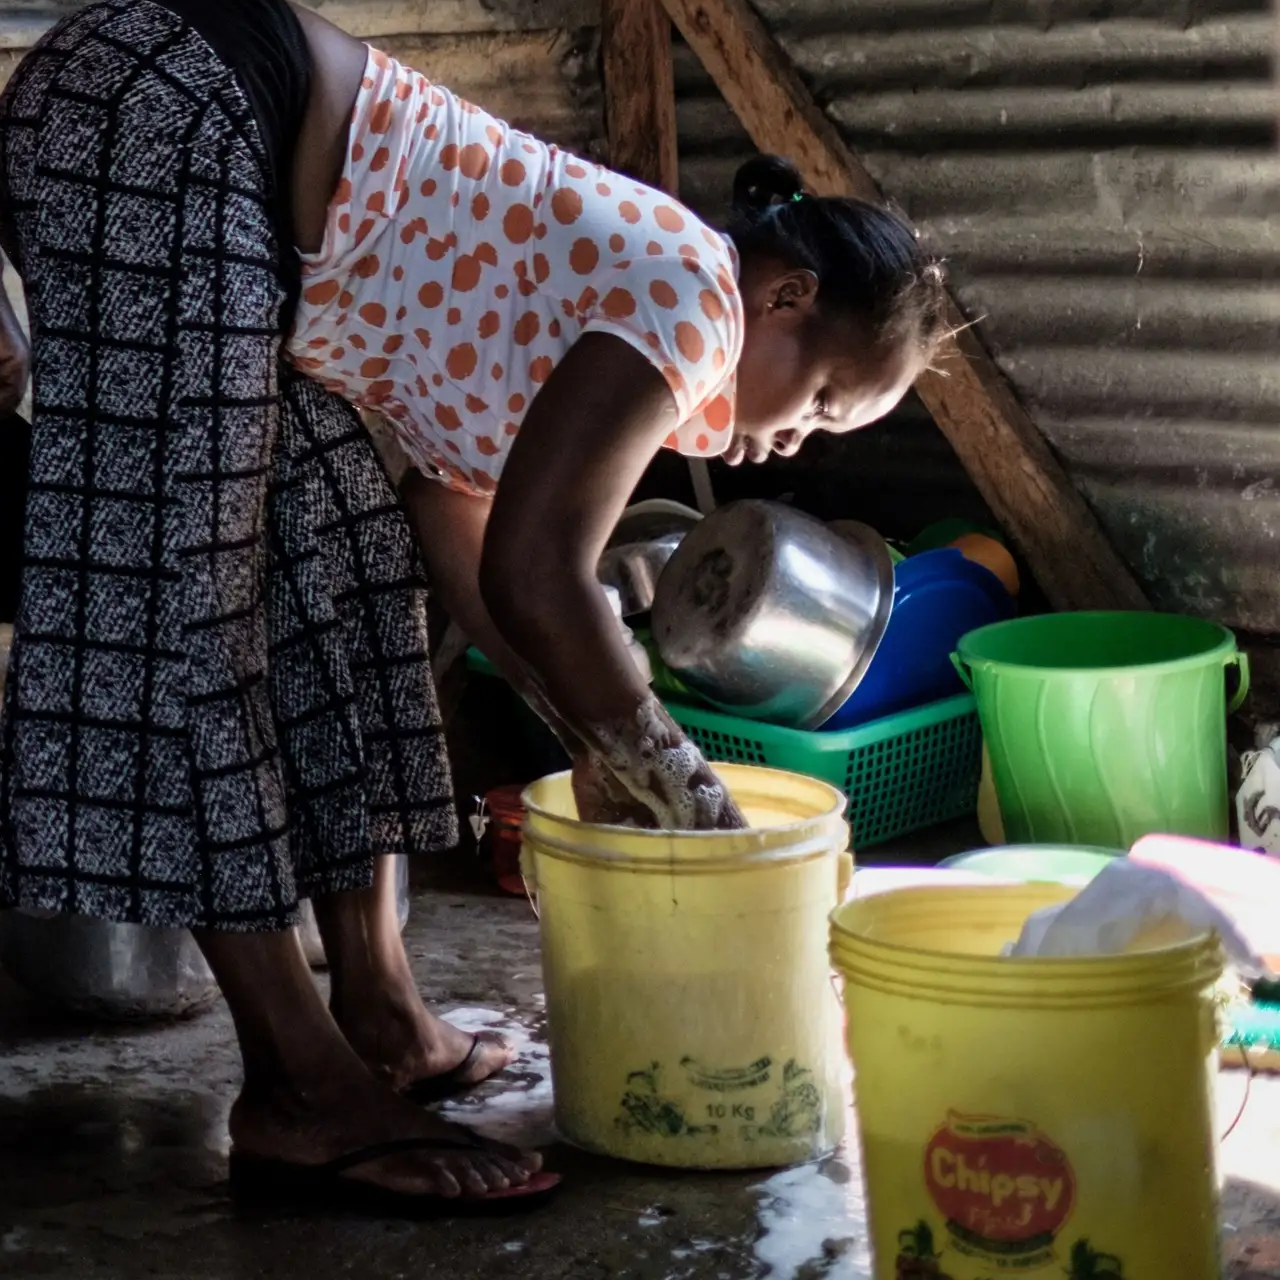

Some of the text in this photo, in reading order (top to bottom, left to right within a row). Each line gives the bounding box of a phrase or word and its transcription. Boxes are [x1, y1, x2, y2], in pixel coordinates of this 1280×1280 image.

[706, 1103, 756, 1120] 10 Kg
[930, 1147, 1063, 1211] Chipsy
